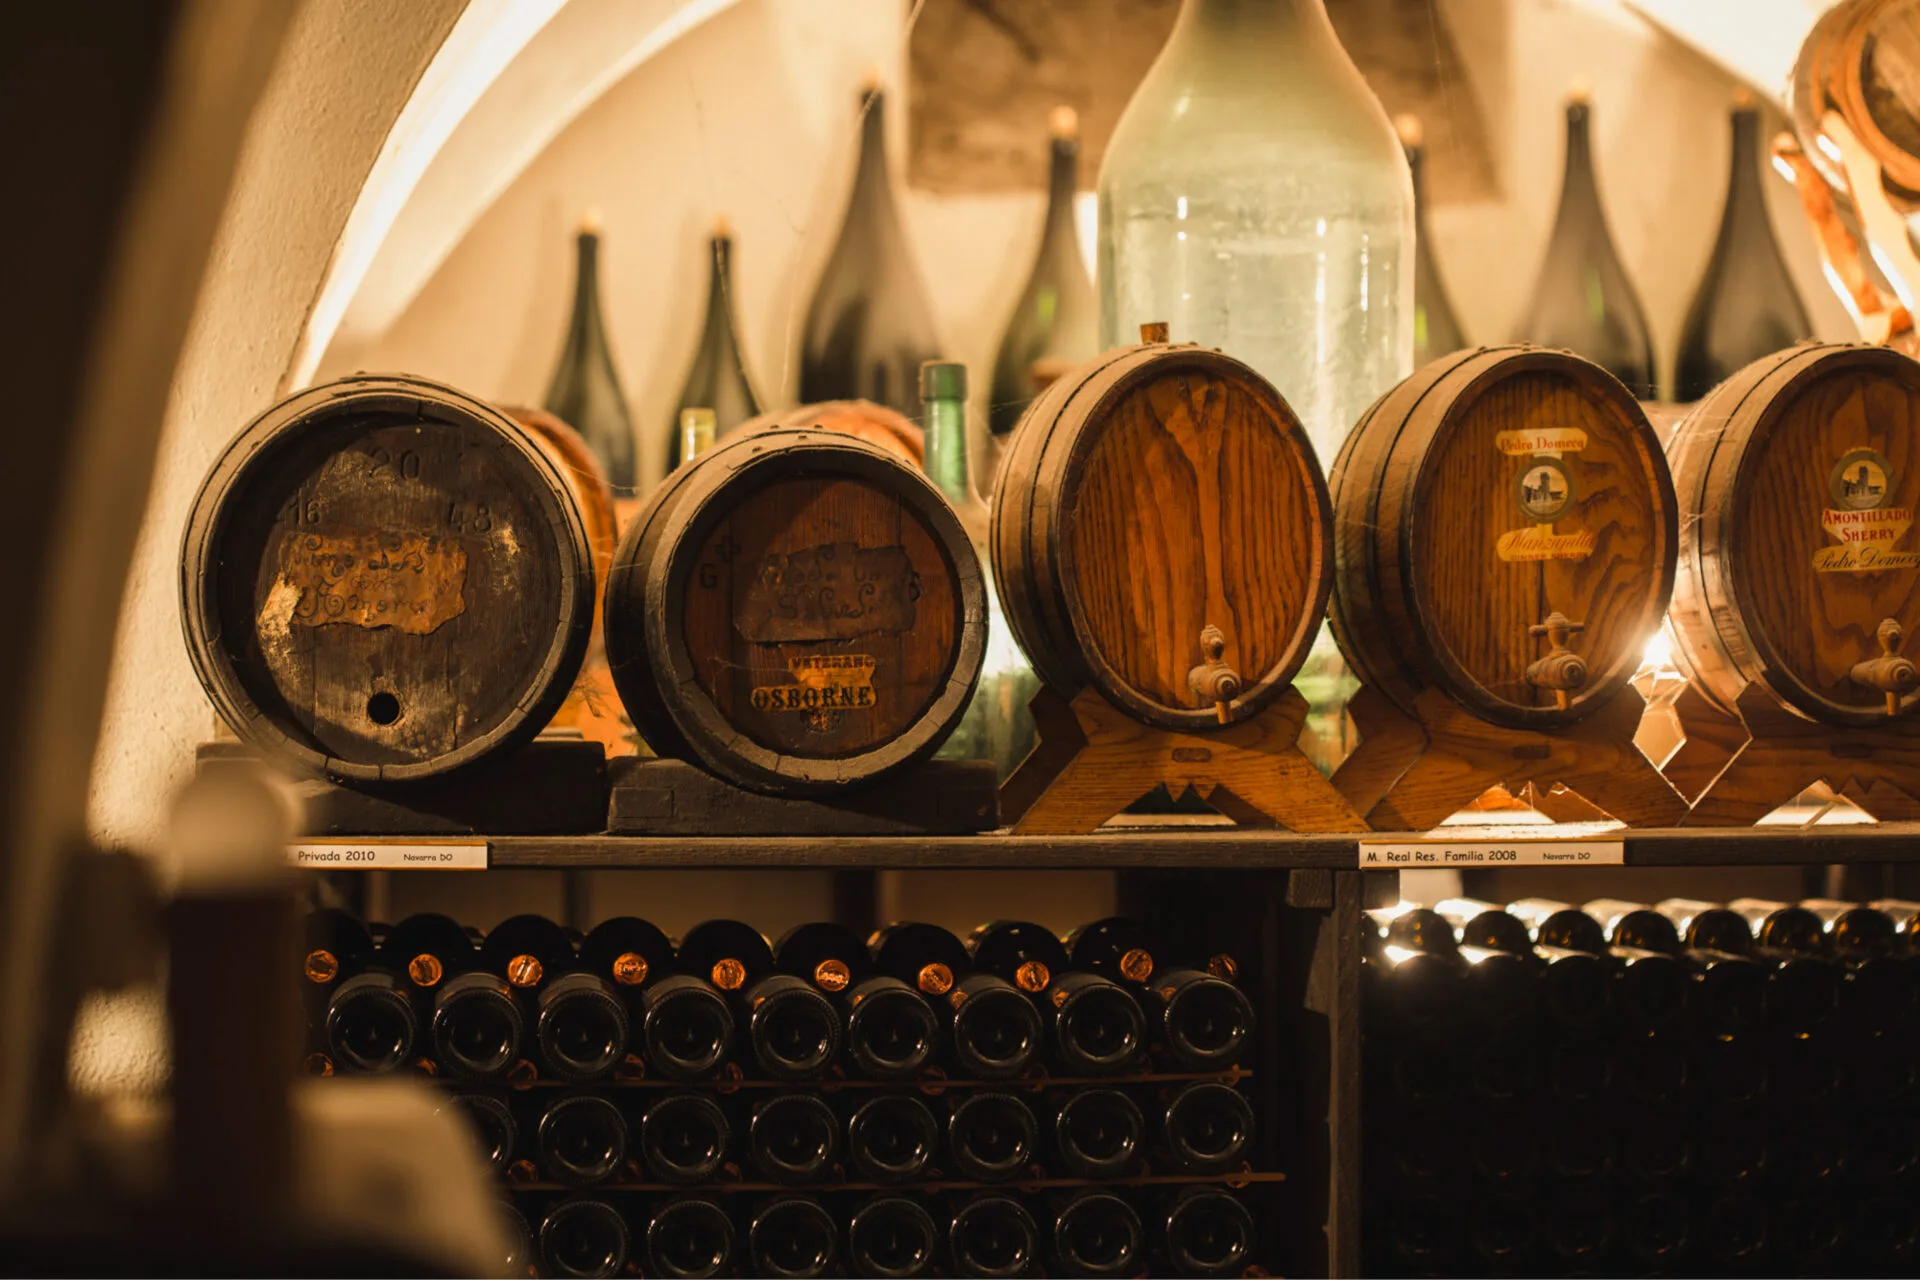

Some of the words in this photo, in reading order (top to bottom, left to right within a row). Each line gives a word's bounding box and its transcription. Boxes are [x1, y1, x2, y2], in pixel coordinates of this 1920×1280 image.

[1500, 438, 1533, 451] Pedro
[1536, 435, 1584, 449] Domecq
[1823, 509, 1912, 526] AMONTILLADO
[1842, 527, 1896, 543] SHERRY
[1819, 550, 1857, 569] Pedro
[791, 656, 876, 669] VETERANO
[753, 686, 871, 710] OSBORNE
[298, 850, 341, 861] Privada
[345, 850, 376, 861] 2010
[403, 853, 437, 862] Navarra
[439, 853, 453, 862] DO
[1366, 851, 1381, 862] M.
[1386, 851, 1411, 861] Real
[1415, 851, 1440, 862] Res.
[1444, 850, 1485, 861] Familia
[1488, 850, 1517, 861] 2008
[1542, 852, 1575, 861] Navarra
[1577, 852, 1591, 861] DO
